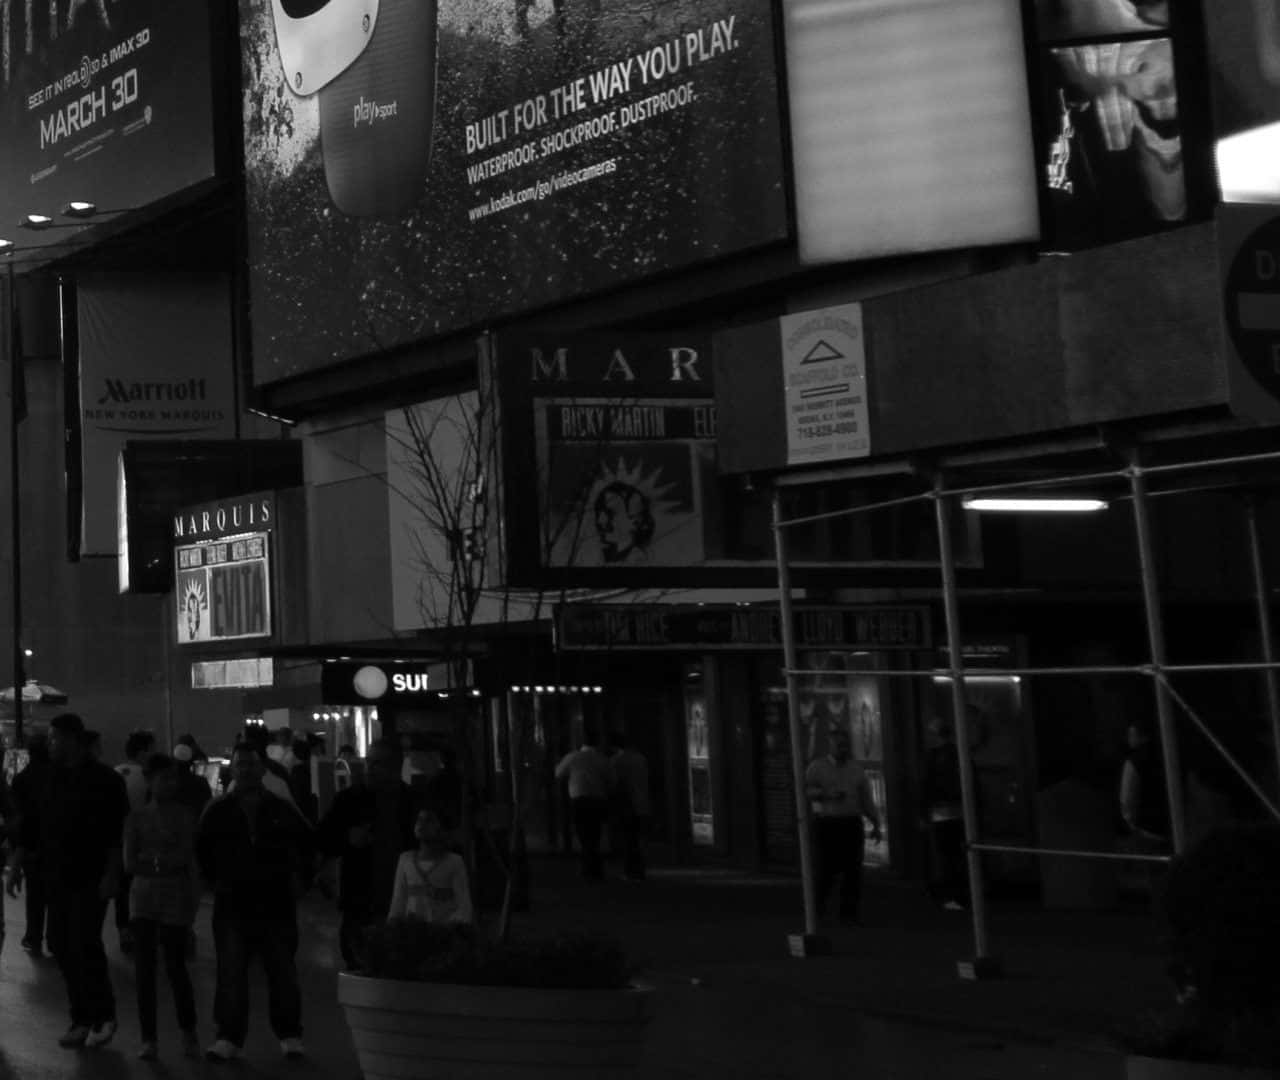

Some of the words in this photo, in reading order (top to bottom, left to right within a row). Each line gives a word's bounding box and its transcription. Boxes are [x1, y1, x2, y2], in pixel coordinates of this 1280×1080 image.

[109, 36, 135, 65] IMAX
[466, 110, 509, 155] BUILT
[514, 94, 548, 136] FOR
[550, 77, 587, 121] THE
[590, 57, 634, 104] WAY
[636, 38, 682, 86] YOU
[685, 15, 740, 67] PLAY.
[40, 84, 108, 151] MARCH
[111, 67, 139, 112] 30
[466, 141, 540, 185] WATERPROOF.
[540, 111, 620, 158] SHOCKPROOF.
[620, 81, 697, 128] DUSTPROOF.
[1255, 249, 1280, 282] D
[98, 377, 207, 405] Marriott
[85, 408, 117, 420] NEW
[119, 408, 158, 420] YORK
[160, 407, 225, 421] MARQUIS
[560, 406, 605, 439] RICKY
[608, 405, 667, 439] MARTIN
[173, 499, 272, 539] MARQUIS
